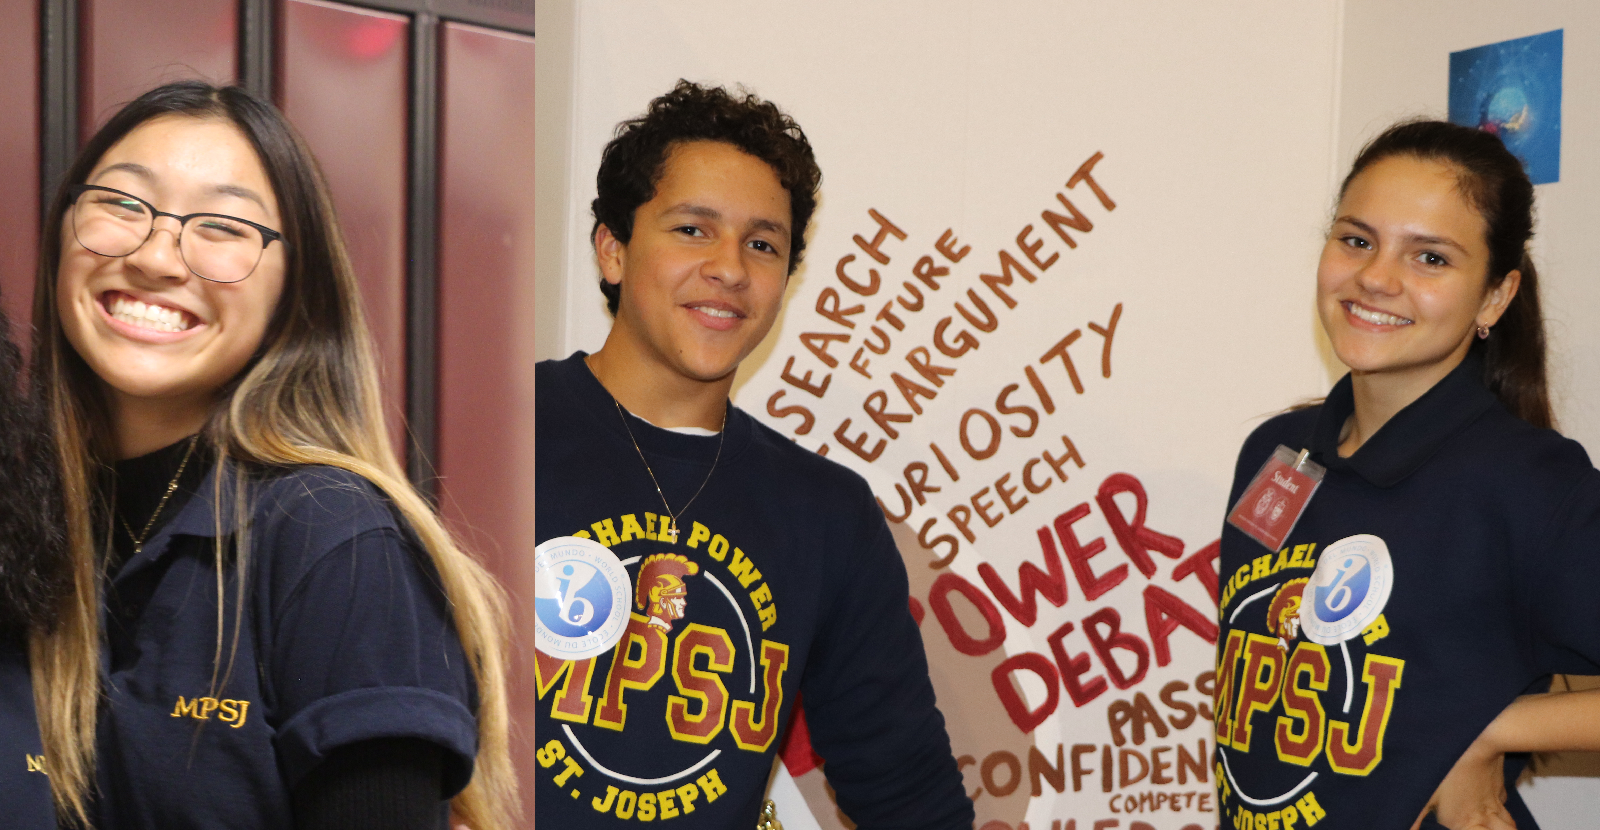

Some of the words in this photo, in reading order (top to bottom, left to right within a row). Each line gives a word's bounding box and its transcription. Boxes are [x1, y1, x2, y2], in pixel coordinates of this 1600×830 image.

[766, 207, 908, 436] SEARCH
[817, 150, 1116, 462] ERARGUMENT
[849, 228, 971, 379] FUTURE
[874, 302, 1124, 523] URIOSITY
[550, 549, 585, 560] MUNDO
[917, 434, 1086, 570] SPEECH
[571, 512, 681, 549] HAEL
[687, 521, 778, 632] POWER
[594, 556, 619, 583] WORLD
[613, 586, 622, 622] SCHOOL
[909, 472, 1186, 657] OWER
[564, 639, 578, 649] DU
[992, 537, 1220, 735] DEBAT
[170, 695, 250, 729] MPSJ
[957, 738, 1217, 801] CONFIDEN
[536, 739, 581, 799] ST.
[592, 768, 728, 822] JOSEPH
[1109, 791, 1214, 813] COMPETE
